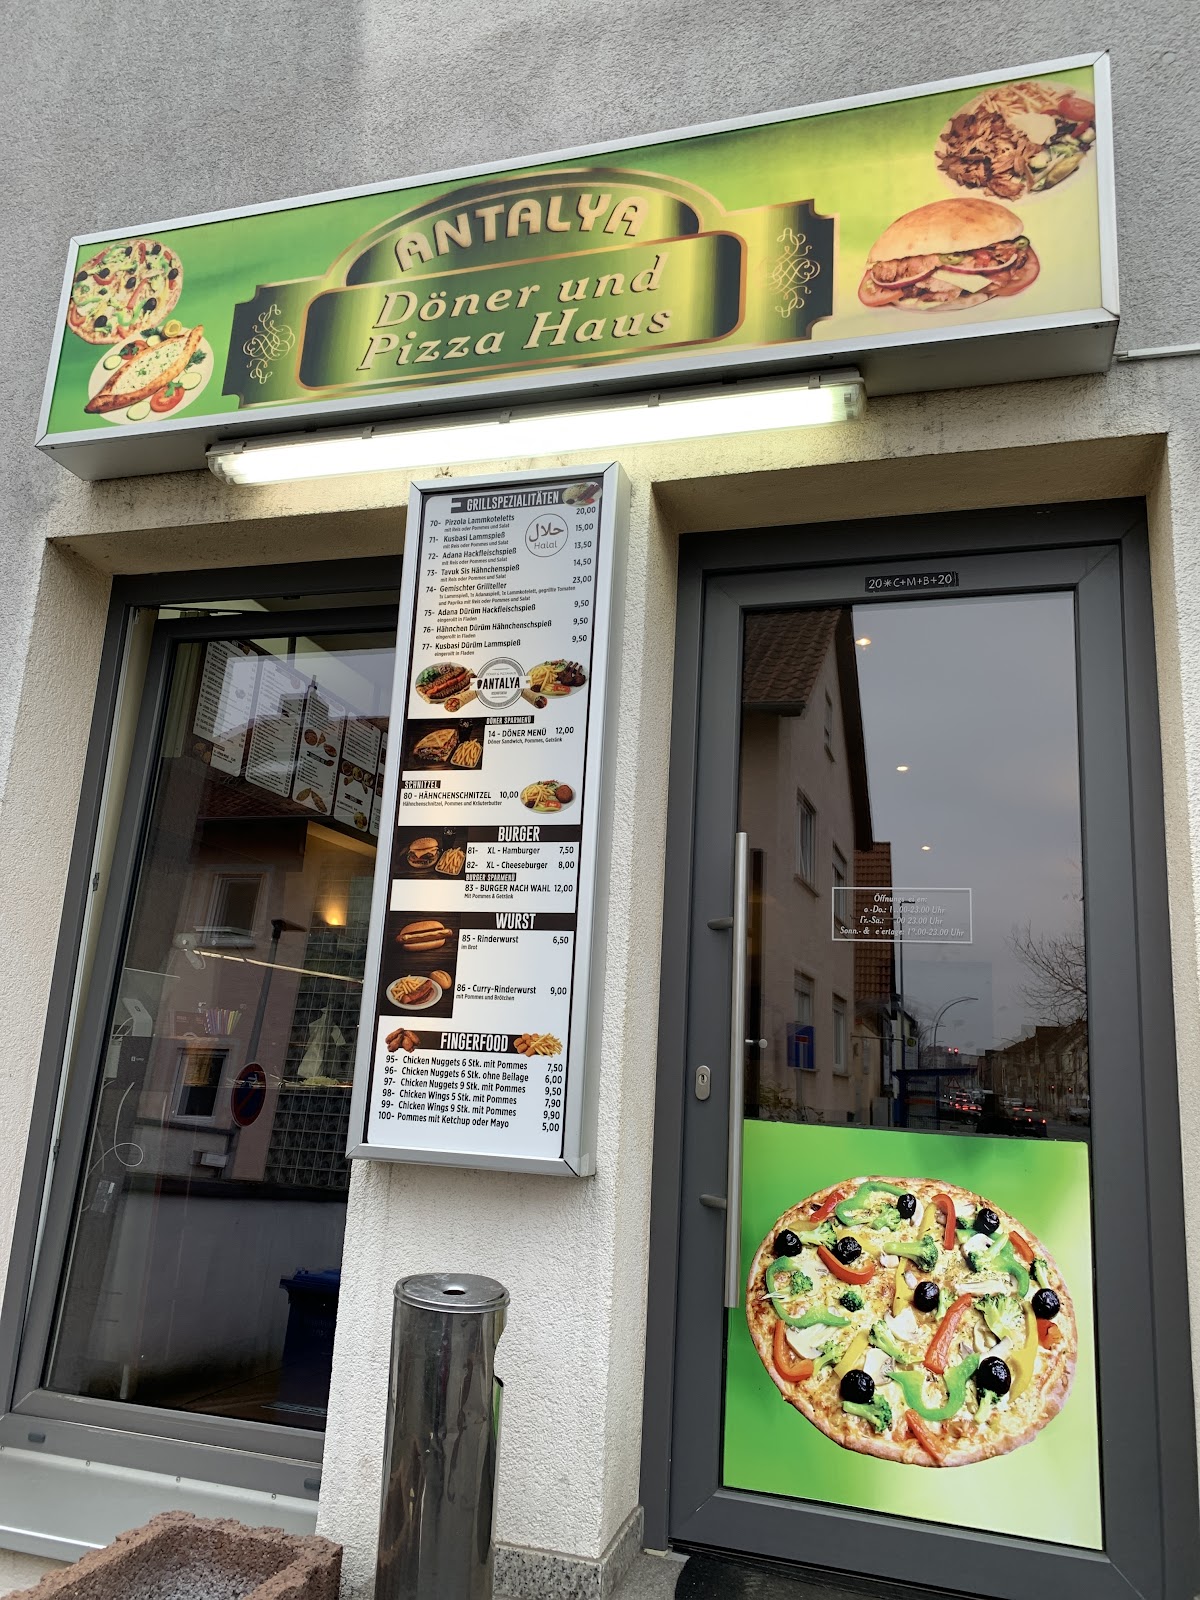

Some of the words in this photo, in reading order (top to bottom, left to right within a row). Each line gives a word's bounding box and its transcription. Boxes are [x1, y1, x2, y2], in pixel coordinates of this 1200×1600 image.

[394, 194, 649, 272] ANTALYA
[372, 284, 541, 329] Döner
[557, 252, 669, 303] und
[356, 330, 505, 371] Pizza
[522, 308, 672, 349] Haus
[466, 491, 559, 511] GRILLSPEZIALITÄTEN
[430, 519, 441, 527] 70-
[444, 518, 466, 526] Pirzola
[467, 514, 515, 524] Lammkoteletts
[576, 506, 596, 515] 20,00
[443, 534, 468, 542] Kusbasi
[469, 531, 505, 541] Lammspieß
[575, 522, 594, 532] 15,00
[529, 522, 564, 542] حلال
[428, 552, 438, 560] 72-
[442, 551, 462, 559] Adana
[463, 547, 517, 557] Hackfleischspieß
[574, 540, 592, 549] 13,50
[534, 541, 558, 549] Halal
[441, 567, 459, 575] Tavuk
[471, 563, 520, 573] Hähnchenspieß
[573, 557, 592, 566] 14,50
[439, 584, 475, 592] Gemischter
[476, 582, 507, 590] Grillteller
[572, 575, 592, 584] 23,00
[437, 608, 458, 616] Adana
[459, 607, 481, 615] Dürüm
[482, 603, 536, 613] Hackfleischspieß
[574, 599, 589, 608] 9,50
[436, 625, 468, 633] Hähnchen
[469, 623, 491, 631] Dürüm
[492, 619, 552, 630] Hähnchenschspieß
[573, 616, 588, 625] 9,50
[435, 641, 460, 650] Kusbasi
[461, 641, 483, 649] Dürüm
[483, 638, 521, 648] Lammspieß
[571, 634, 587, 643] 9,50
[482, 677, 520, 690] ANTALYA
[503, 716, 531, 724] SPARMENÜ
[502, 728, 526, 737] DÖNER
[527, 727, 547, 736] MENÜ
[555, 726, 574, 735] 12,00
[404, 780, 438, 789] SCHNITZEL
[418, 790, 491, 799] HÄHNCHENSCHNITZEL
[499, 790, 519, 799] 10,00
[498, 826, 540, 841] BURGER
[467, 846, 478, 854] 81-
[487, 846, 495, 854] XL
[502, 846, 540, 855] Hamburger
[559, 846, 574, 855] 7,50
[466, 861, 478, 869] 82-
[486, 861, 494, 869] XL
[501, 861, 548, 870] Cheeseburger
[558, 860, 575, 869] 8,00
[466, 873, 486, 881] BURGER
[487, 873, 514, 881] SPARMENÜ
[480, 884, 508, 892] BURGER
[509, 884, 529, 892] NACH
[530, 884, 550, 892] WAHL
[554, 884, 573, 893] 12,00
[931, 905, 946, 914] Uhr
[495, 912, 536, 929] WURST
[929, 916, 943, 925] Uhr
[461, 934, 471, 942] 85
[477, 934, 518, 943] Rinderwurst
[552, 936, 569, 944] 6,50
[950, 928, 965, 937] Uhr
[456, 983, 466, 992] 86
[472, 984, 536, 994] Curry-Rinderwurst
[550, 986, 567, 995] 9,00
[440, 1032, 508, 1052] FINGERFOOD
[385, 1054, 398, 1063] 95-
[402, 1055, 430, 1065] Chicken
[431, 1056, 460, 1067] Nuggets
[461, 1058, 467, 1067] 6
[467, 1058, 482, 1068] Stk.
[483, 1060, 495, 1068] mit
[496, 1060, 527, 1070] Pommes
[547, 1063, 563, 1072] 7,50
[384, 1065, 397, 1074] 96-
[401, 1066, 429, 1076] Chicken
[430, 1068, 459, 1078] Nuggets
[460, 1069, 465, 1078] 6
[466, 1070, 481, 1079] Stk.
[482, 1071, 500, 1080] ohne
[502, 1072, 529, 1082] Beilage
[544, 1074, 562, 1084] 6,00
[383, 1077, 395, 1085] 97-
[400, 1077, 427, 1087] Chicken
[428, 1079, 458, 1090] Nuggets
[459, 1081, 465, 1090] 9
[466, 1081, 479, 1090] Stk.
[481, 1082, 493, 1091] mit
[495, 1083, 526, 1093] Pommes
[544, 1086, 562, 1096] 9,50
[382, 1088, 395, 1097] 98-
[399, 1089, 426, 1099] Chicken
[428, 1091, 450, 1101] Wings
[451, 1092, 456, 1101] 5
[457, 1092, 471, 1101] Stk.
[472, 1094, 484, 1102] mit
[486, 1094, 517, 1105] Pommes
[545, 1098, 561, 1108] 7,90
[381, 1099, 394, 1108] 99-
[398, 1100, 425, 1110] Chicken
[427, 1102, 449, 1113] Wings
[450, 1103, 455, 1112] 9
[456, 1104, 470, 1113] Stk.
[471, 1105, 484, 1114] mit
[485, 1106, 516, 1116] Pommes
[543, 1110, 560, 1120] 9,90
[378, 1111, 394, 1120] 100-
[397, 1111, 427, 1122] Pommes
[428, 1114, 440, 1123] mit
[441, 1115, 470, 1126] Ketchup
[471, 1117, 489, 1126] oder
[490, 1118, 509, 1129] Mayo
[542, 1122, 559, 1132] 5,00
